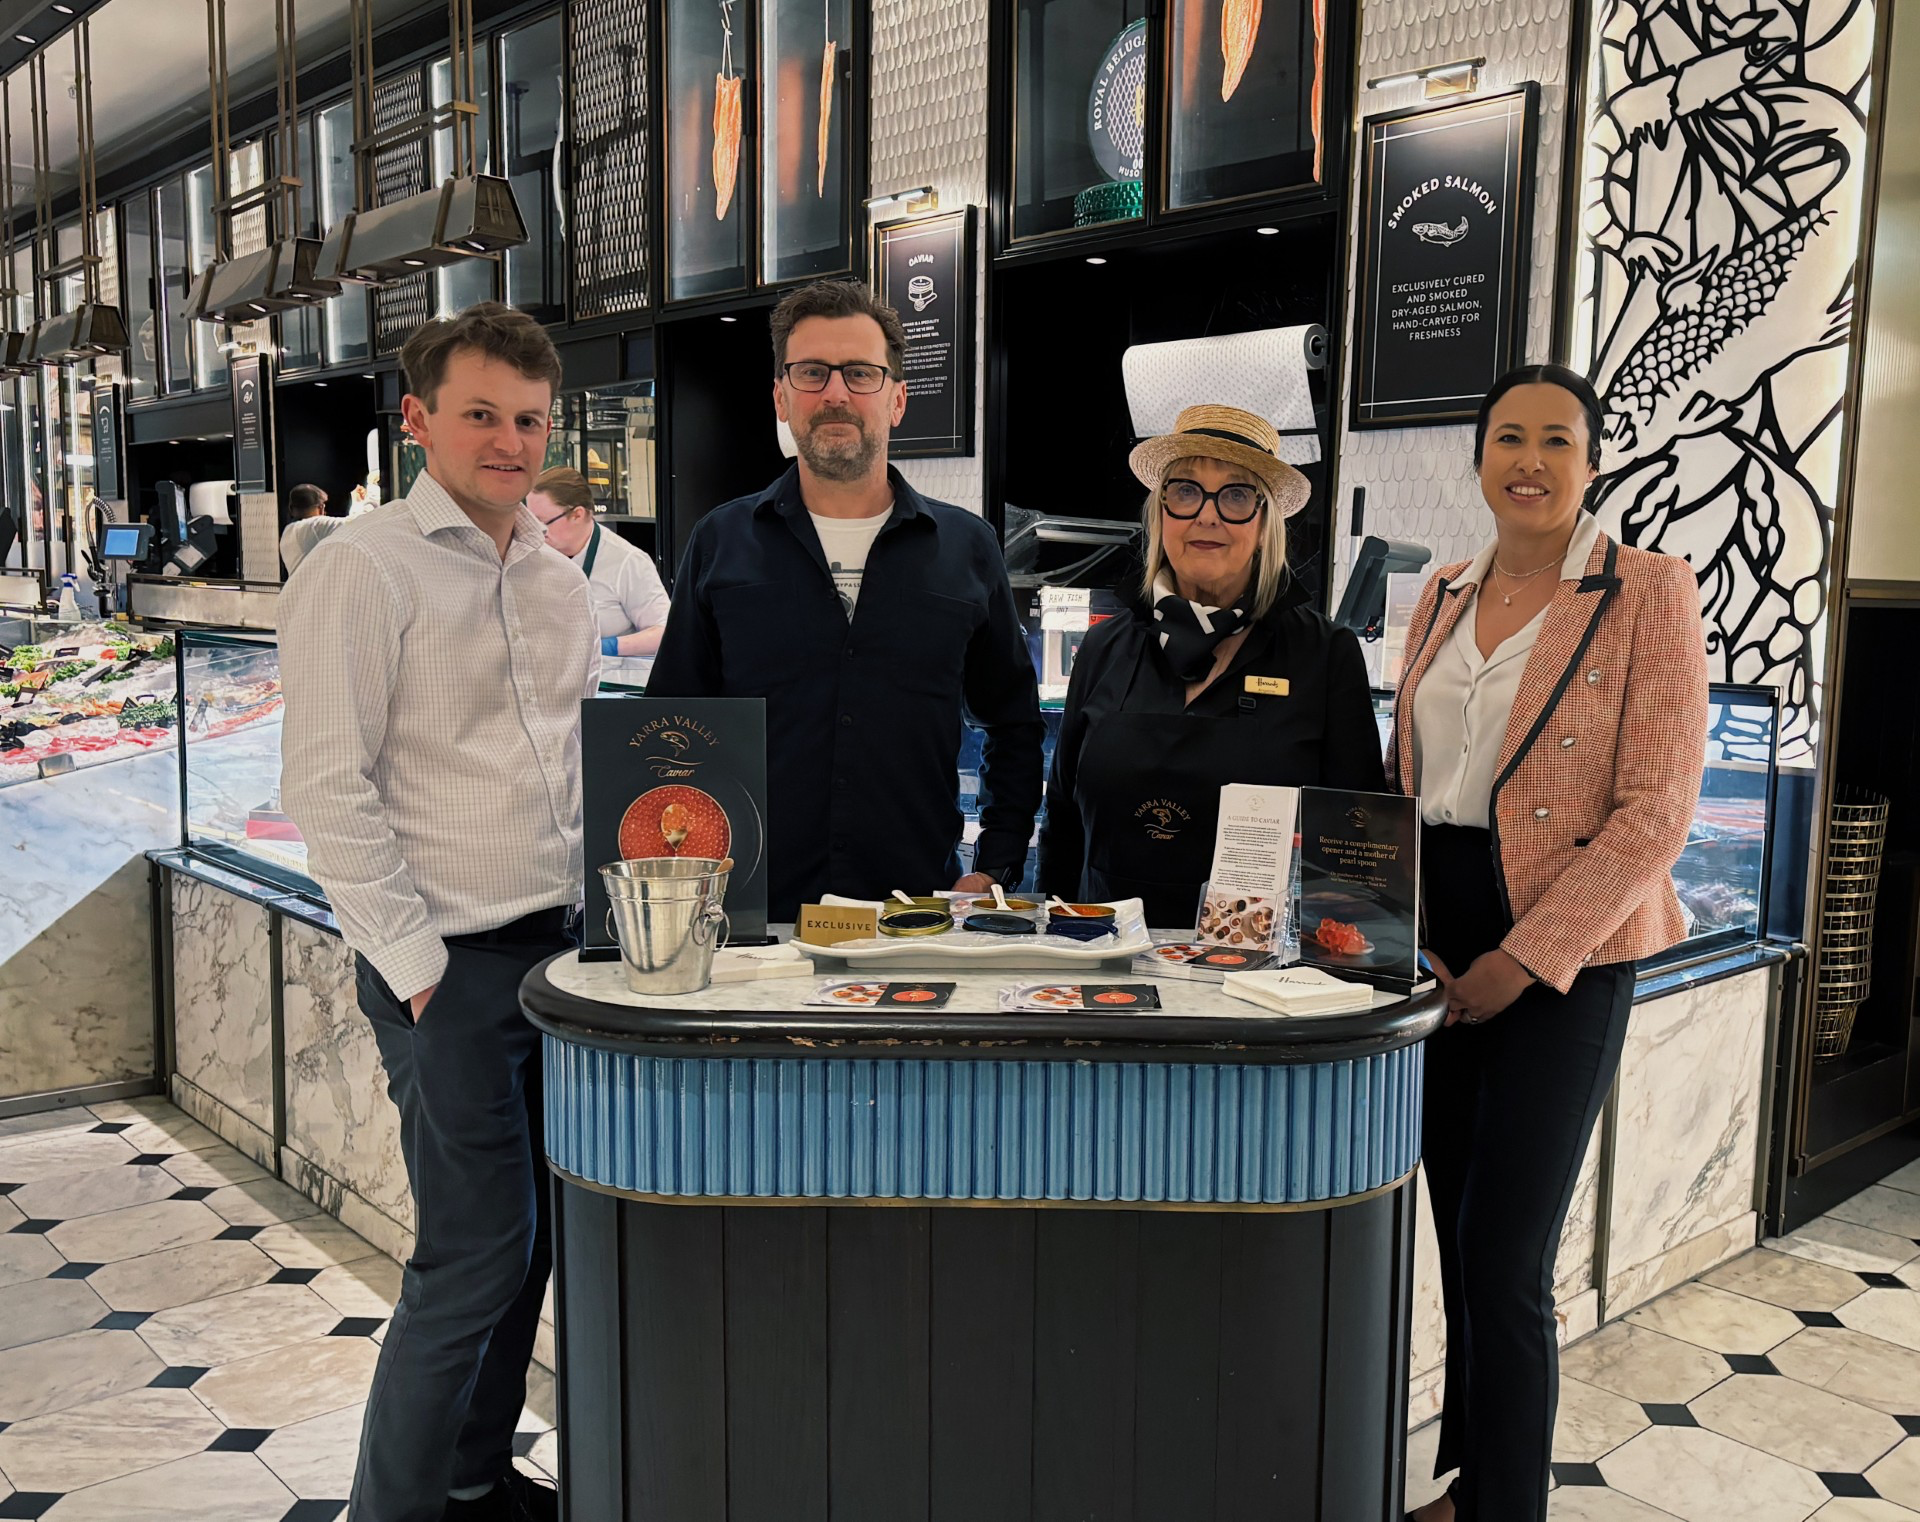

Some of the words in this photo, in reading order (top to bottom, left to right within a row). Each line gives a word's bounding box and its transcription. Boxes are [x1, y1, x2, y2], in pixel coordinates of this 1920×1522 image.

[1094, 76, 1109, 131] ROYAL
[1118, 165, 1140, 178] HUSO
[1387, 178, 1440, 230] SMOKED
[1444, 175, 1497, 215] SALMON
[908, 254, 934, 267] CAVIAR
[1392, 278, 1451, 294] EXCLUSIVELY
[1453, 274, 1485, 286] CURED
[1406, 293, 1426, 304] AND
[1429, 289, 1468, 301] SMOKED
[1391, 305, 1437, 318] DRY-AGED
[1393, 315, 1458, 330] HAND-CARVED
[1461, 313, 1480, 323] FOR
[1409, 327, 1461, 340] FRESHNESS
[1049, 594, 1064, 603] RAW
[1067, 594, 1083, 602] FISH
[629, 716, 670, 748] YARRA
[674, 715, 720, 747] VALLEY
[650, 765, 695, 778] Caviar
[1134, 799, 1159, 818] YARRA
[1161, 798, 1191, 820] VALLEY
[1319, 836, 1343, 846] Receive
[1349, 841, 1399, 852] complimentary
[1321, 847, 1344, 855] opener
[1364, 851, 1388, 859] mother
[1389, 851, 1397, 860] of
[1340, 857, 1356, 865] pearl
[807, 920, 871, 931] EXCLUSIVE
